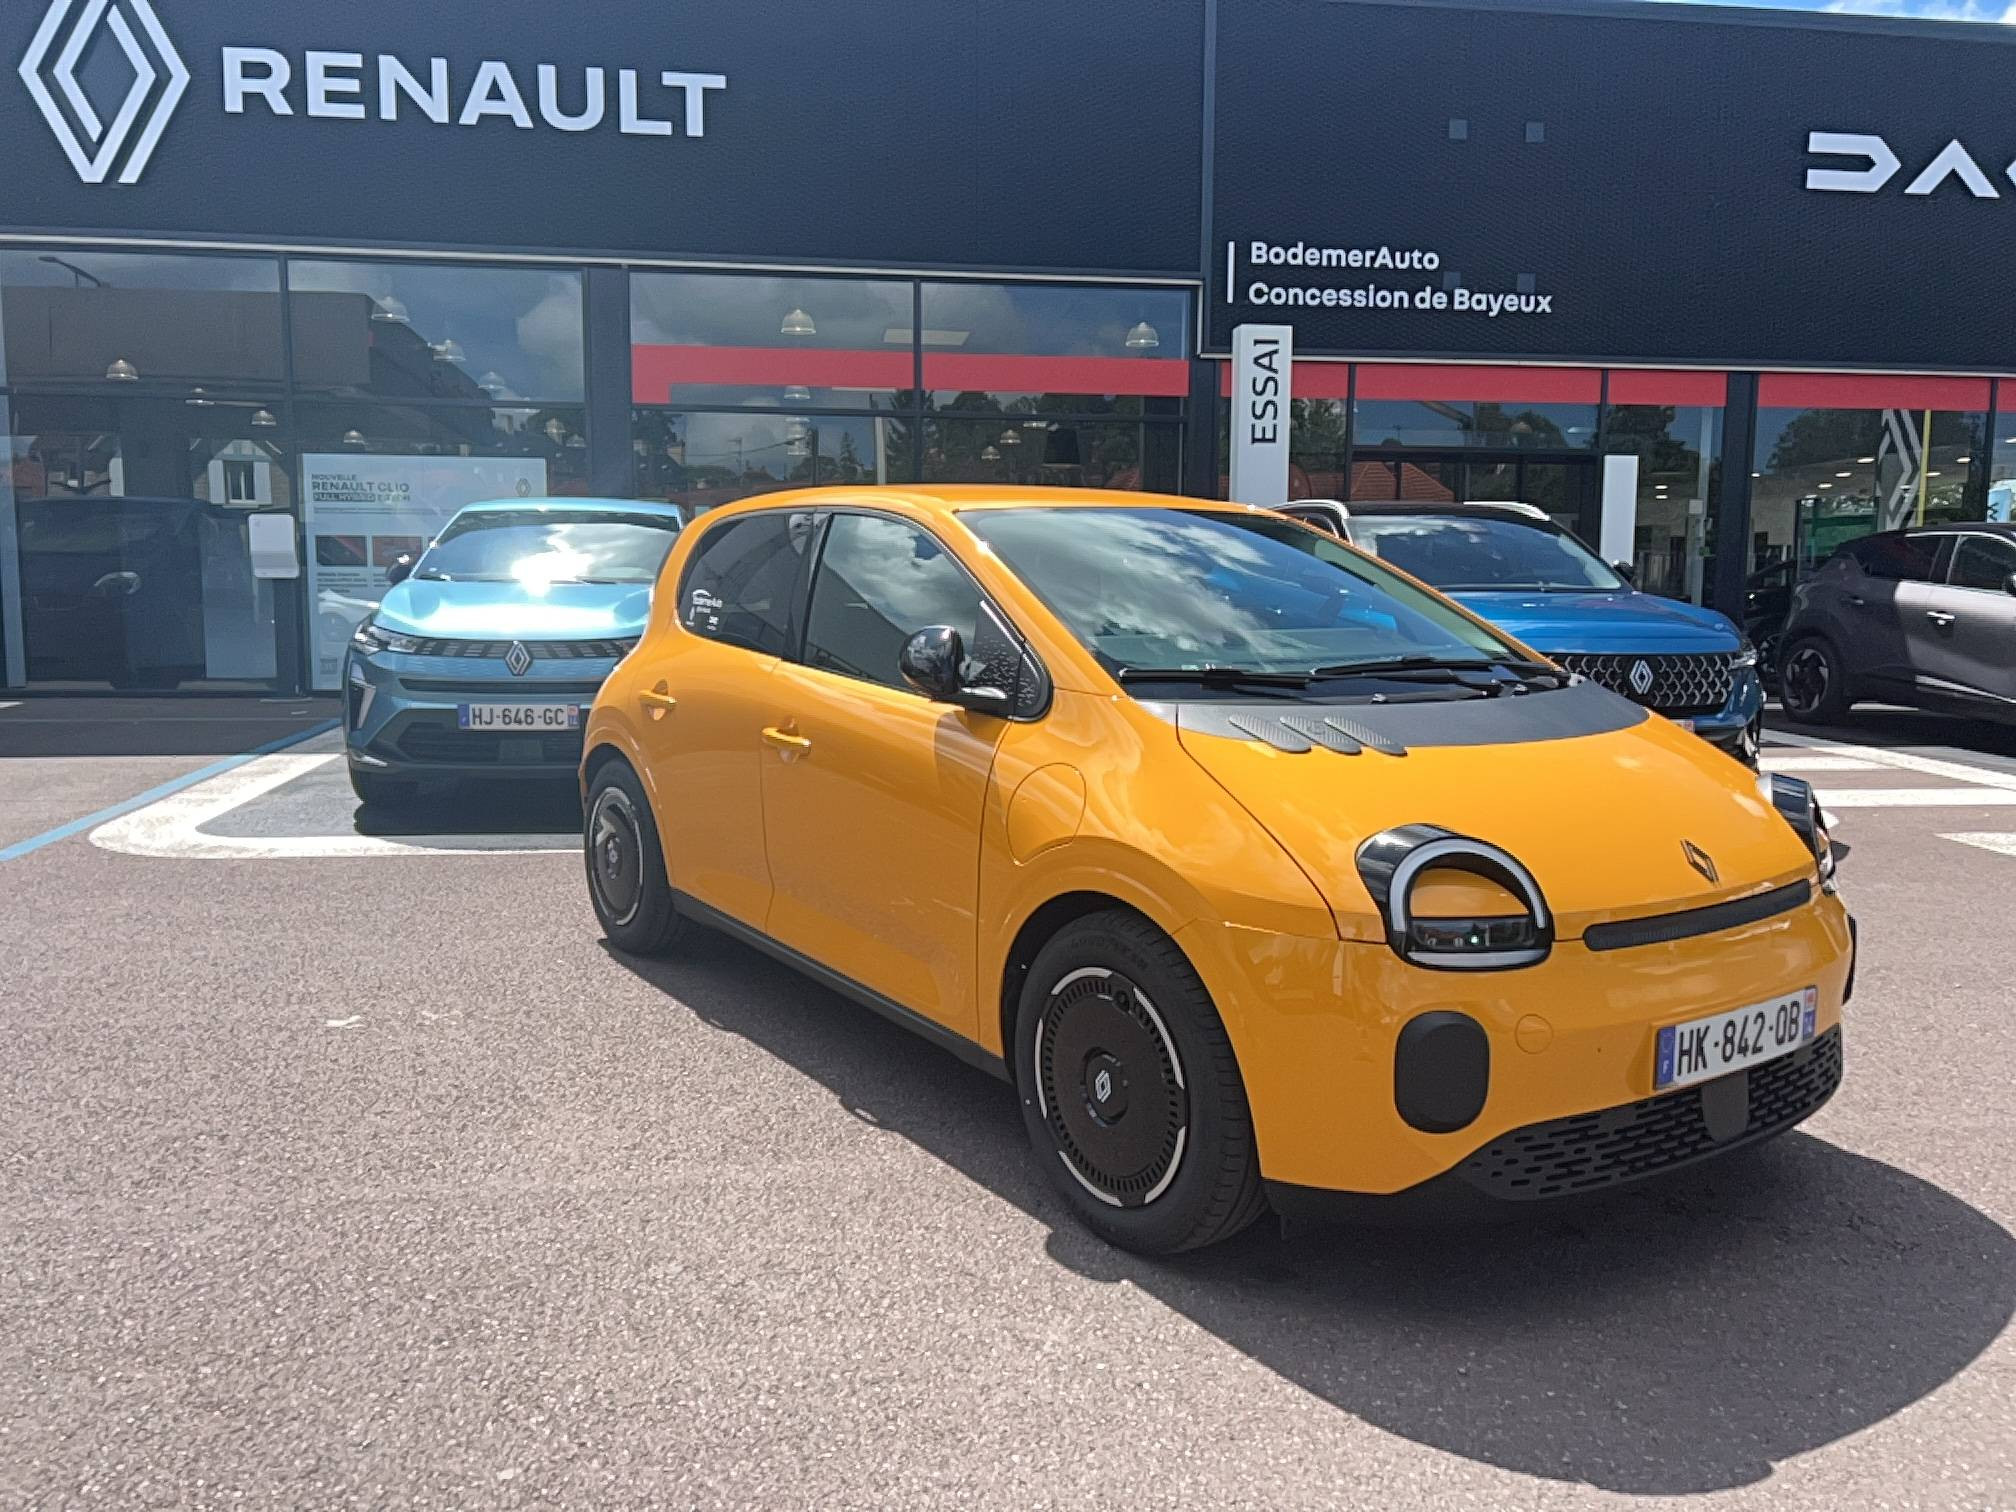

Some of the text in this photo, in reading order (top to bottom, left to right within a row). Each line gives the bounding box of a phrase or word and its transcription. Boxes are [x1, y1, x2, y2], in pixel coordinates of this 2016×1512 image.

[221, 46, 727, 137] RENAULT
[1806, 131, 2016, 199] DA
[1250, 241, 1440, 270] BodemerAuto
[1249, 282, 1552, 317] Concession de Bayeux
[1251, 338, 1280, 444] ESSAI
[311, 481, 410, 493] RENAULT CLIO
[471, 708, 565, 726] HJ-646-GC
